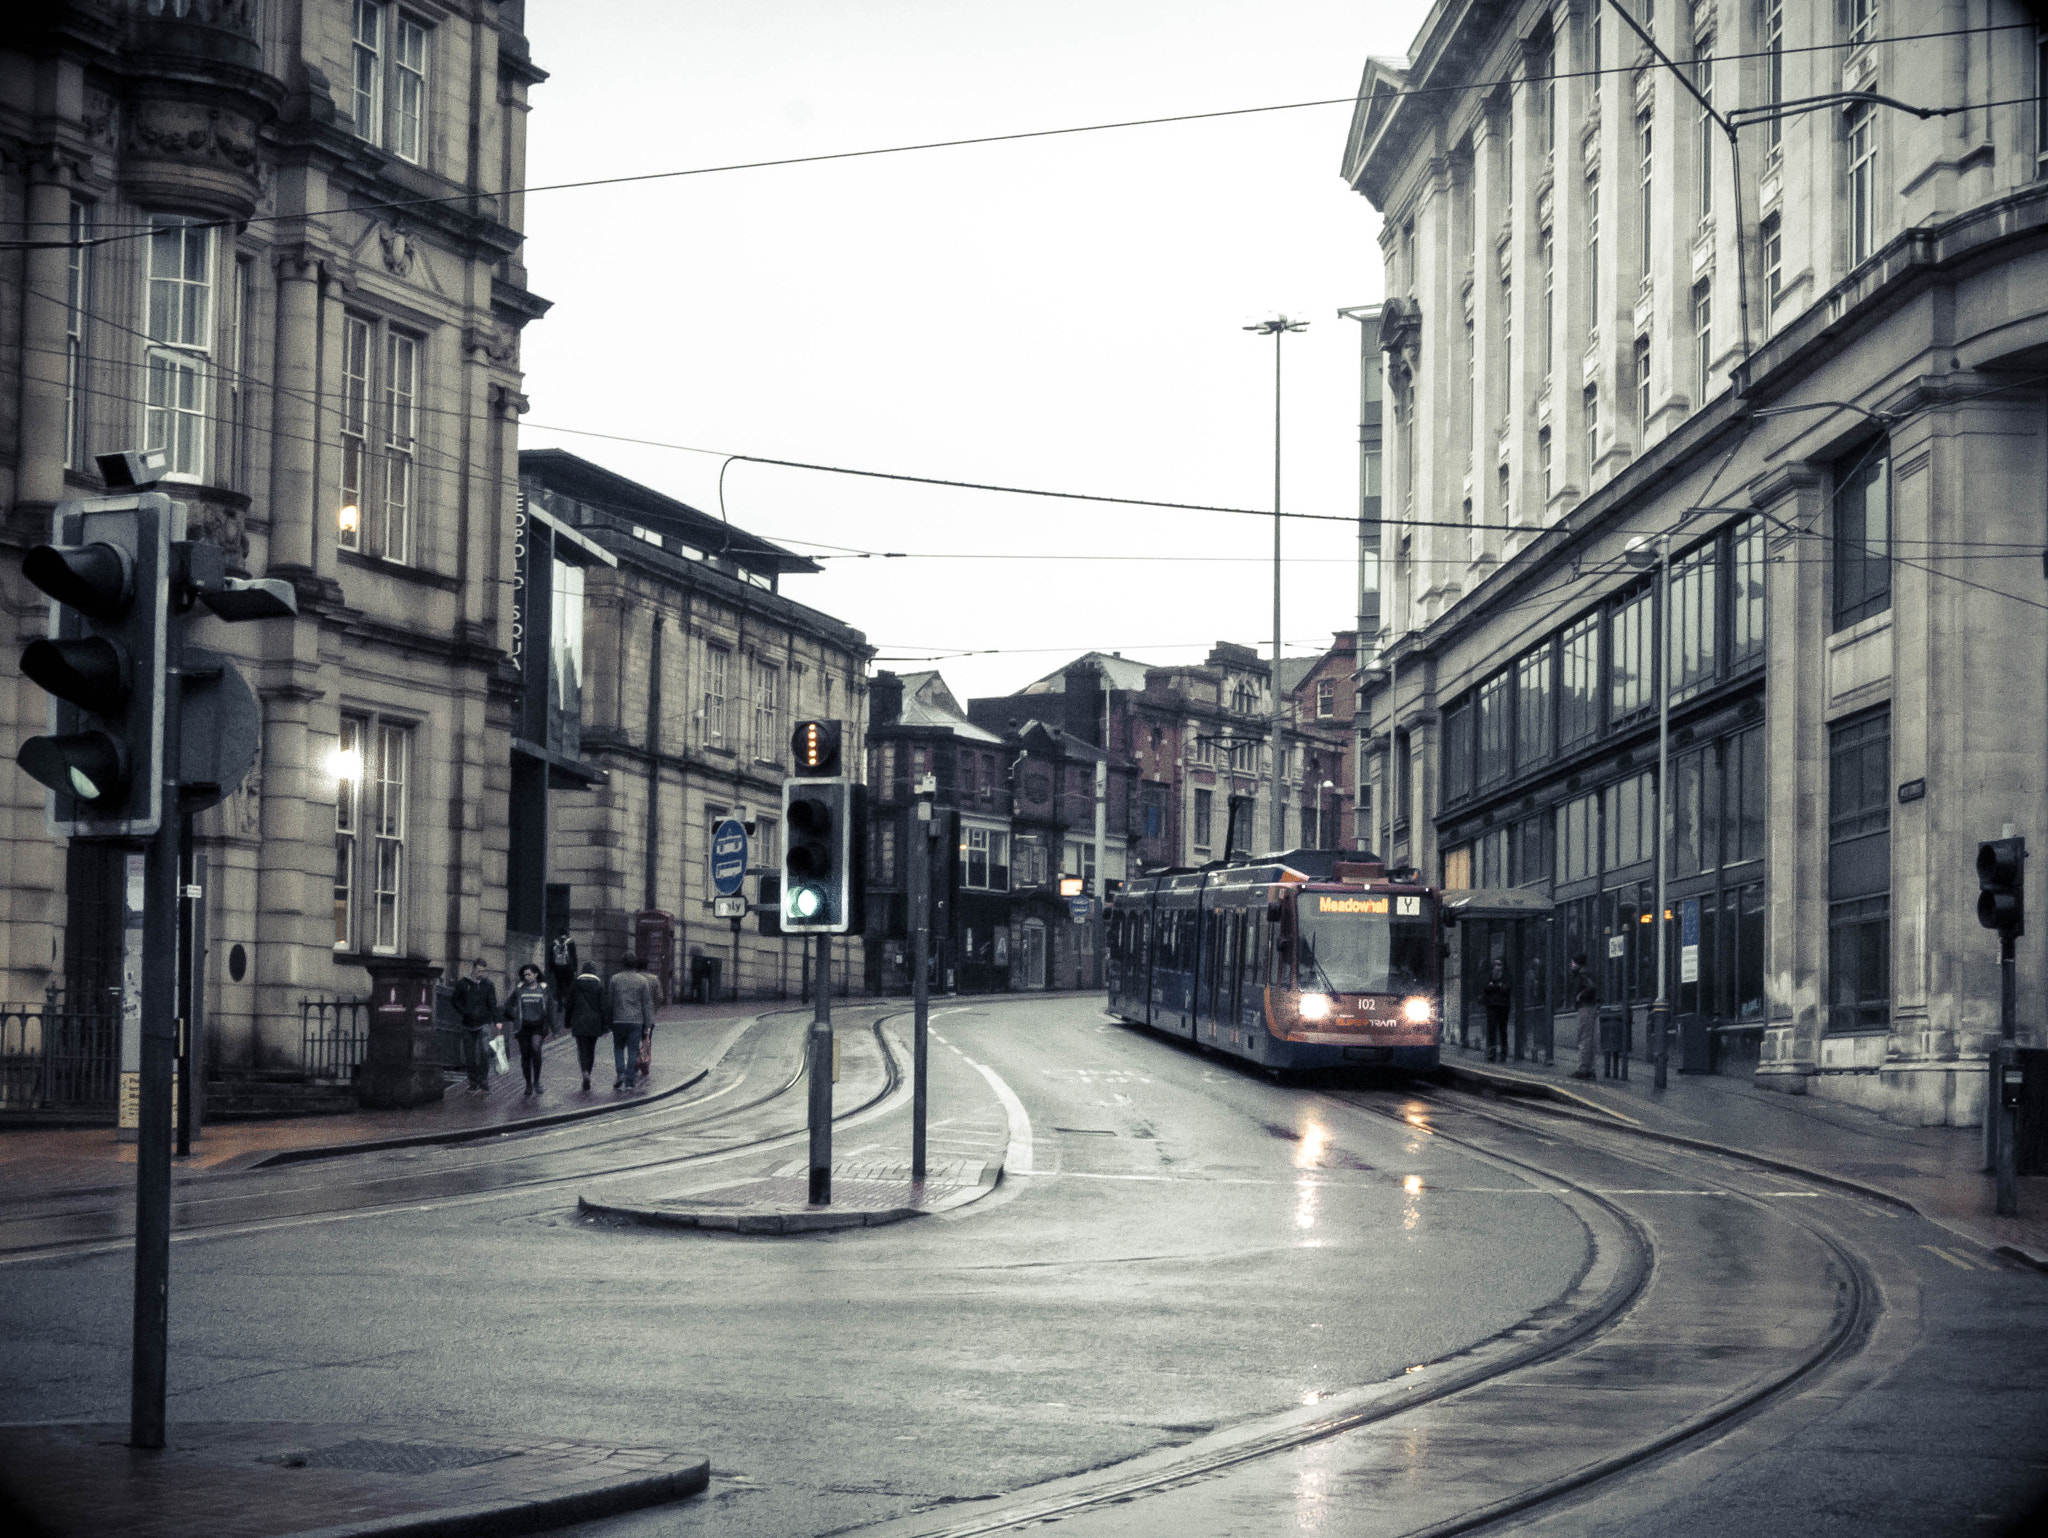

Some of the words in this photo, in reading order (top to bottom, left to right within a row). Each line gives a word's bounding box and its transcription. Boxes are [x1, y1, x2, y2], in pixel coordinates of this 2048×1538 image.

[1320, 896, 1388, 913] Meadowhall
[1404, 898, 1413, 913] Y
[1358, 998, 1376, 1010] 102
